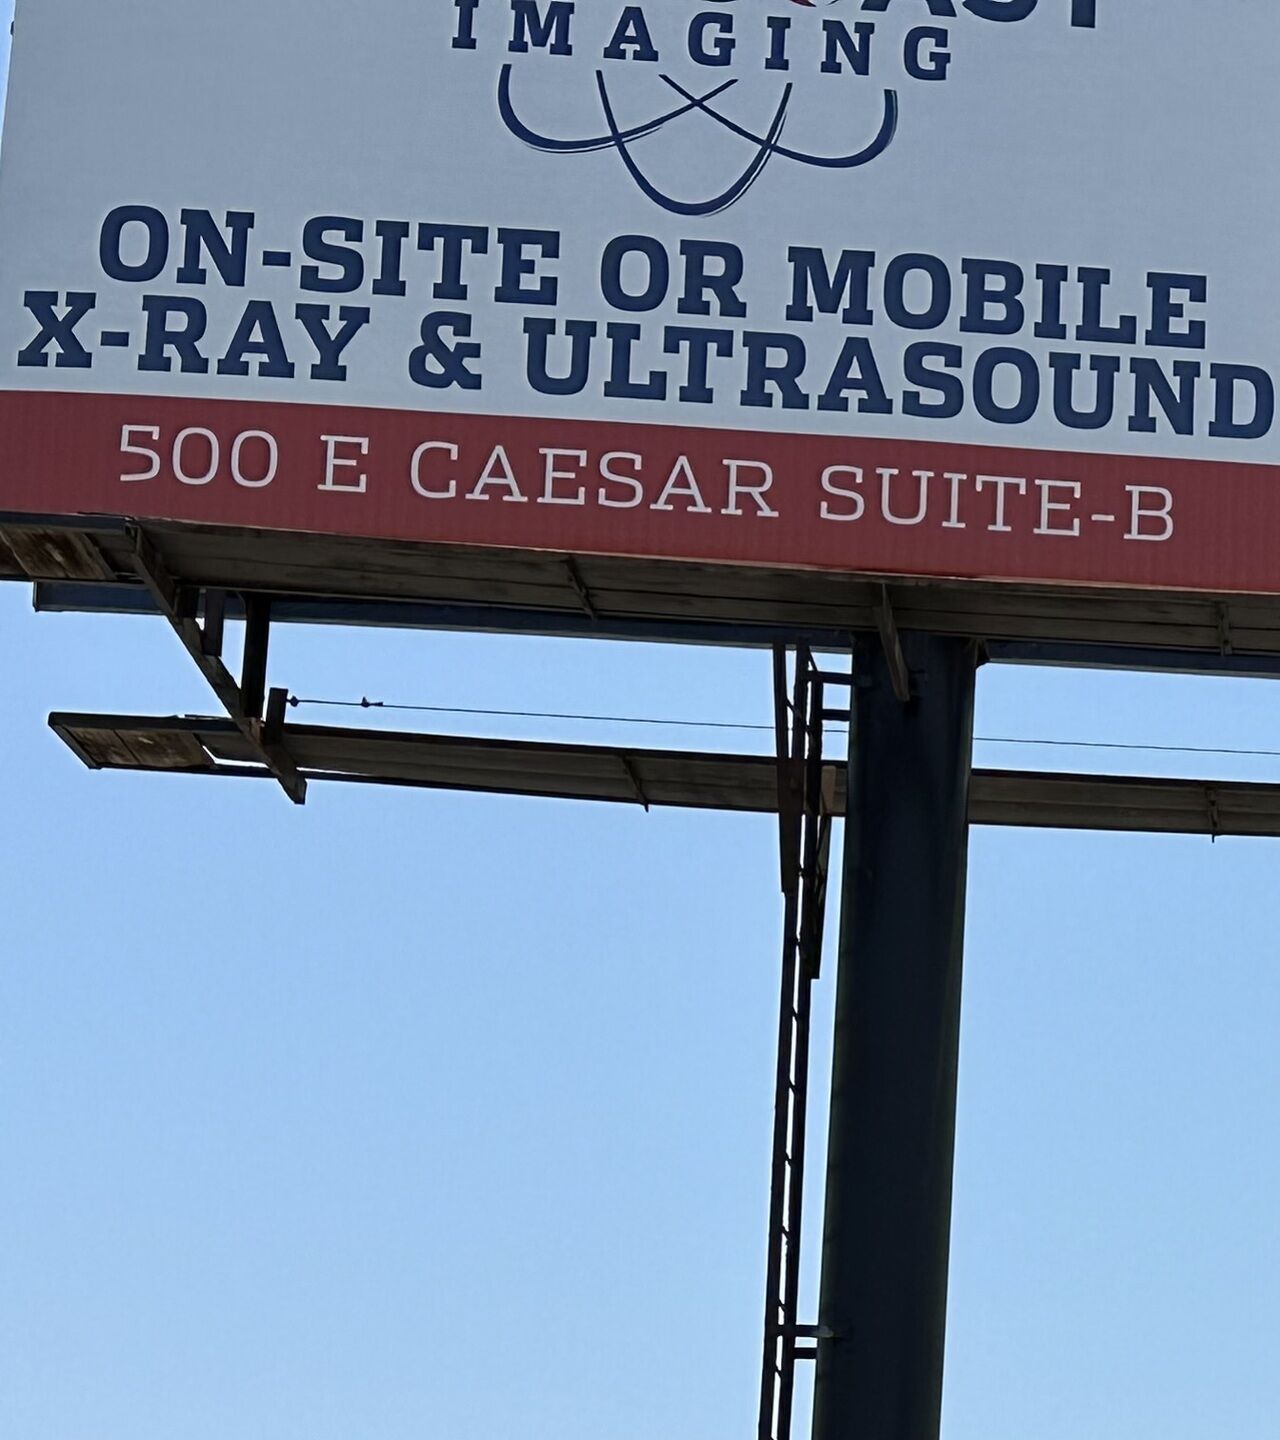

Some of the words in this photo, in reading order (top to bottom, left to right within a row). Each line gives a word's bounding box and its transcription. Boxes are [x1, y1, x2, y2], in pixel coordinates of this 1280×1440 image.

[452, 0, 951, 80] IMAGING
[99, 205, 560, 305] ON-SITE
[600, 235, 747, 318] OR
[785, 246, 1207, 348] MOBILE
[17, 290, 370, 381] X-RAY
[408, 311, 482, 389] &
[523, 317, 1275, 439] ULTRASOUND
[119, 424, 278, 487] 500
[317, 435, 369, 493] E
[409, 441, 779, 518] CAESAR
[820, 465, 1174, 541] SUITE-B
